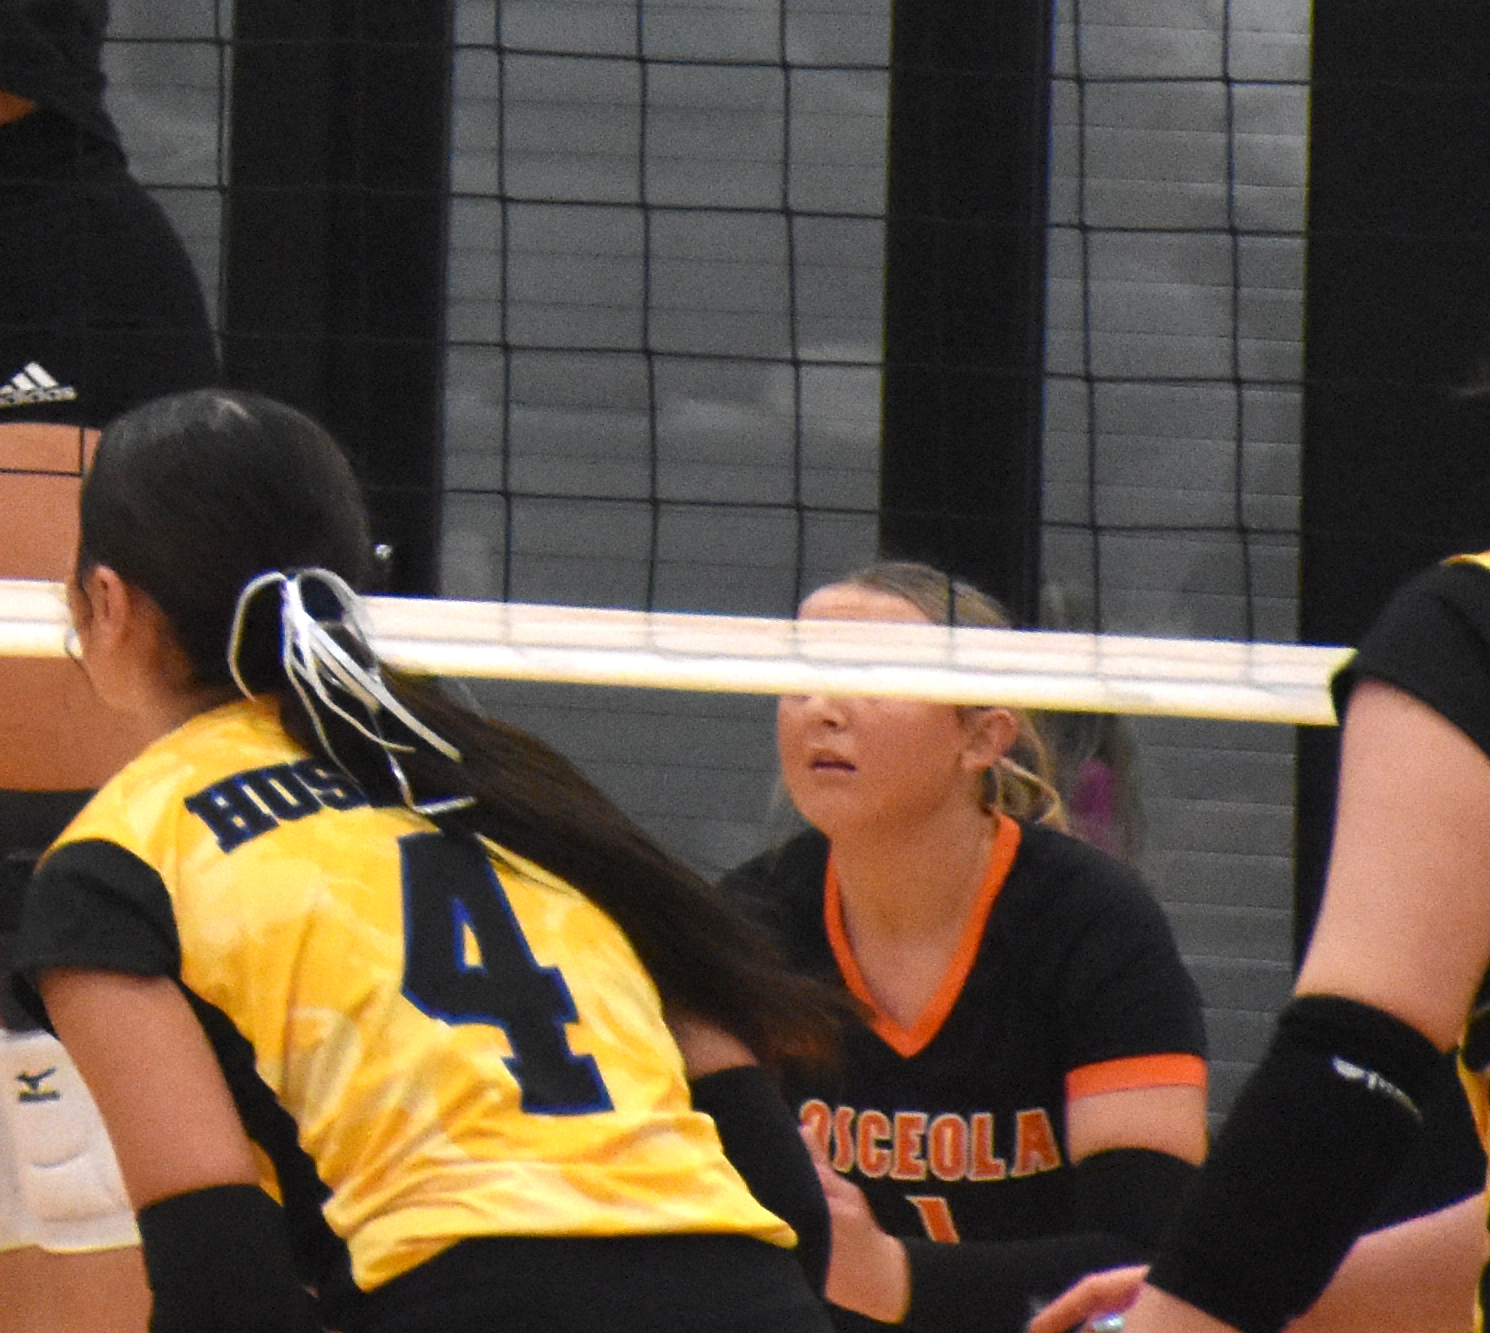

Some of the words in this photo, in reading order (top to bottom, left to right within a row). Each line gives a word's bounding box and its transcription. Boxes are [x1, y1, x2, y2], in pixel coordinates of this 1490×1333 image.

[183, 757, 370, 855] HUS
[398, 829, 616, 1116] 4
[798, 1098, 1062, 1181] OSCEOLA
